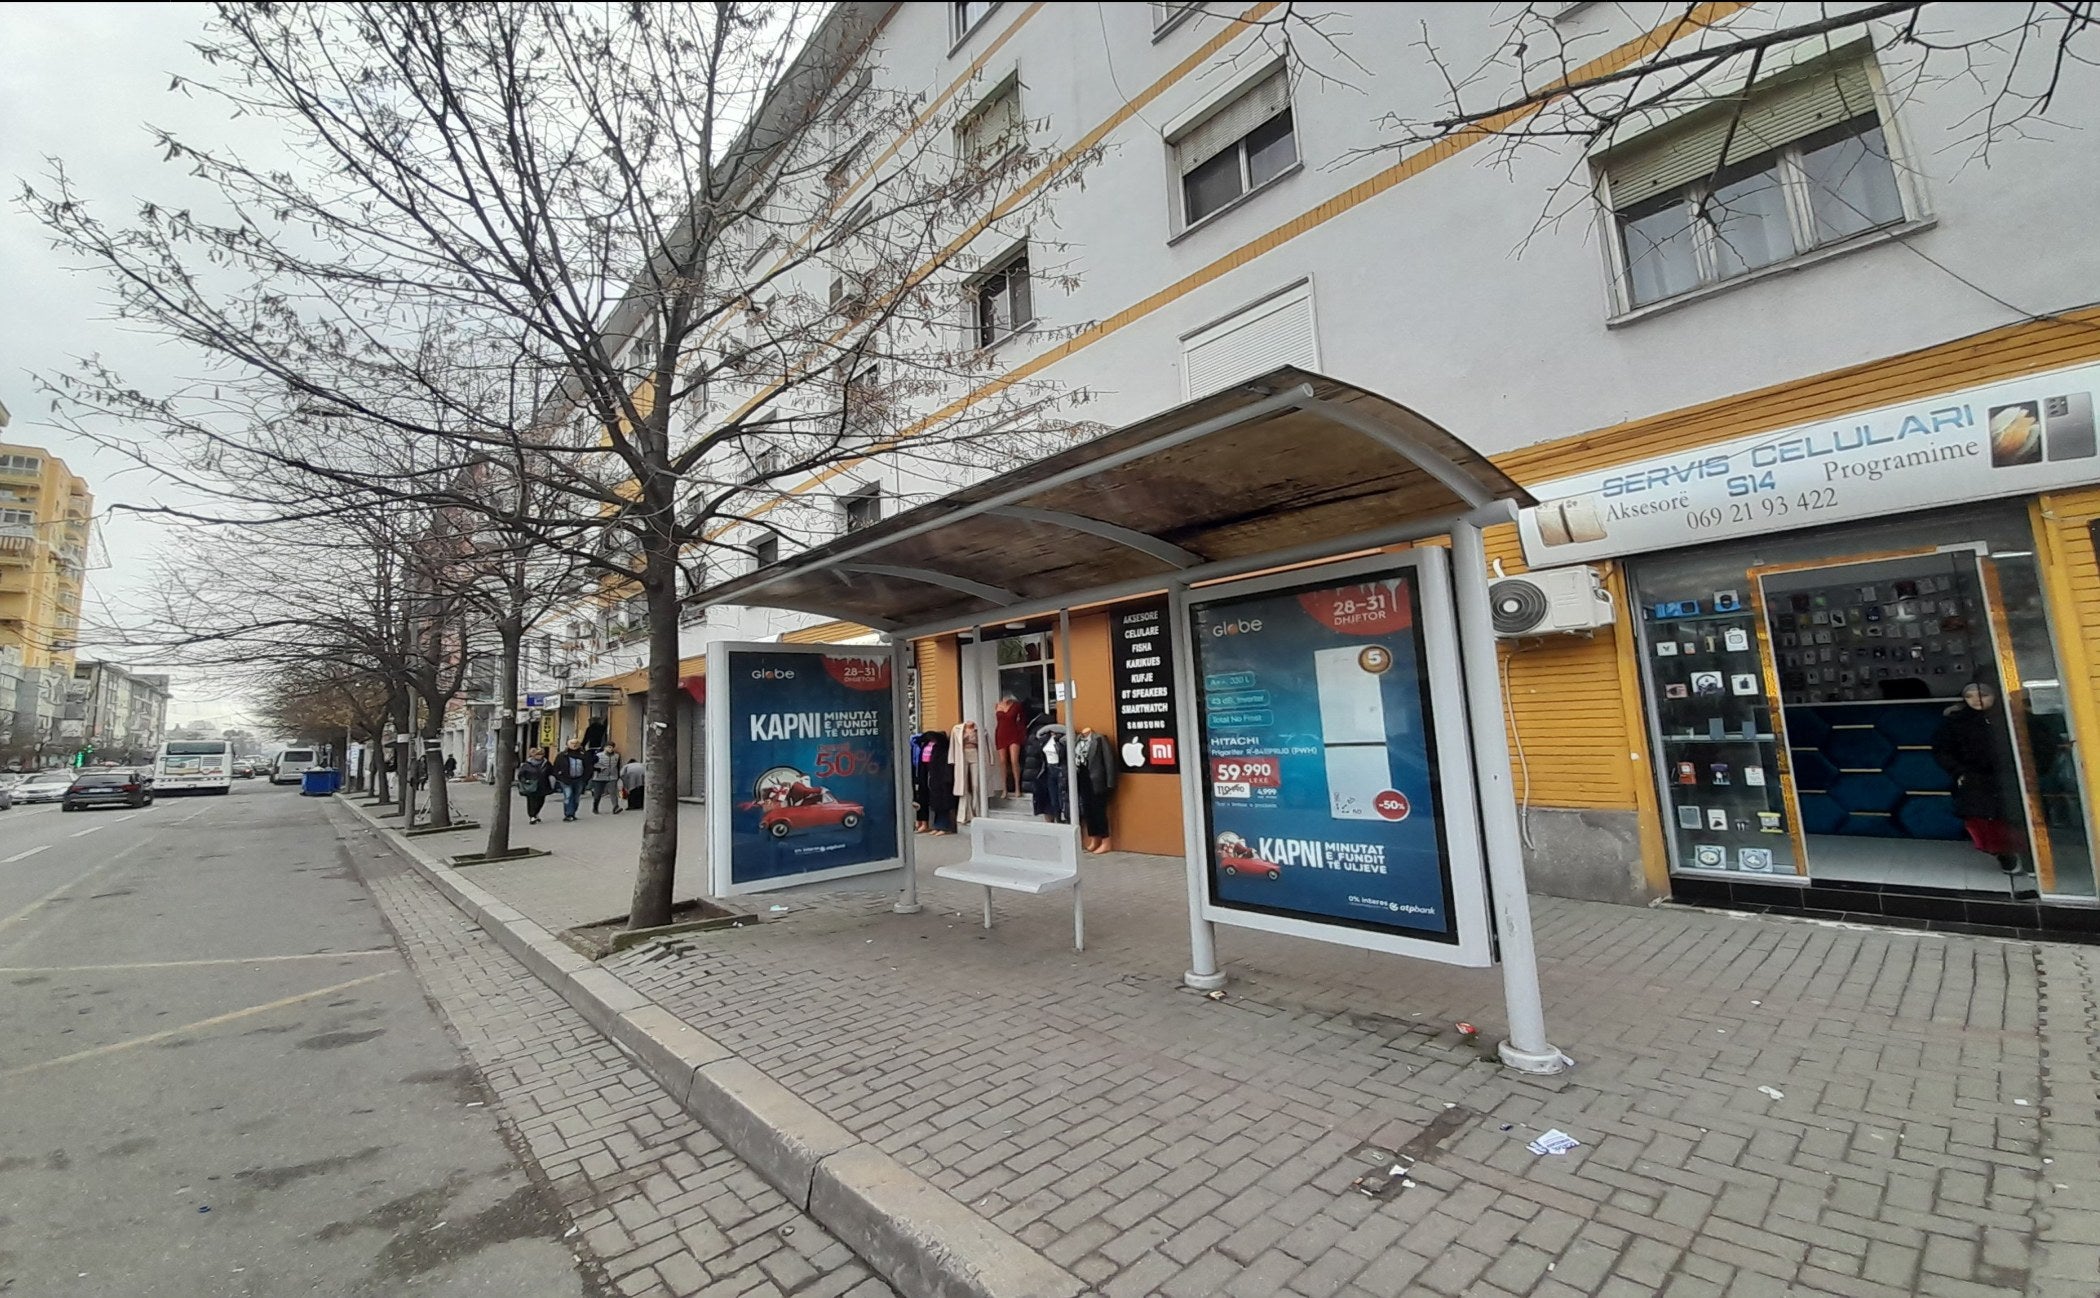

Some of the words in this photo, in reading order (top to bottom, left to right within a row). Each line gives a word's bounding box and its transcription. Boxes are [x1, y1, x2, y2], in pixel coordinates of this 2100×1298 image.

[1602, 455, 1730, 498] SERVIS
[1751, 404, 1974, 468] CELULARI
[1823, 437, 1980, 482] Programime
[1727, 470, 1776, 498] S14
[1687, 507, 1722, 531] 069
[1731, 502, 1753, 523] 21
[1762, 495, 1789, 518] 93
[1796, 487, 1838, 512] 422
[1123, 611, 1159, 624] AKSESORE
[1334, 610, 1386, 626] DHJETOR
[1124, 626, 1159, 639] CELULARE
[1132, 642, 1152, 653] FISHA
[1126, 656, 1161, 669] KARIKUES
[1367, 651, 1382, 665] 5
[751, 668, 795, 679] Globe
[1131, 673, 1153, 683] KUFJE
[1132, 687, 1168, 699] SPEAKERS
[1121, 703, 1168, 714] SMARTWATCH
[824, 711, 878, 720] MINUTAT
[1212, 715, 1229, 723] Total
[750, 712, 821, 741] KAPNI
[824, 721, 832, 729] E
[837, 720, 878, 728] FUNDIT
[1127, 720, 1165, 730] SAMSUNG
[841, 728, 879, 737] ULJEVE
[1210, 737, 1259, 746] HITACHI
[815, 751, 879, 778] 50%
[1218, 764, 1271, 781] 59.990
[1378, 800, 1405, 811] -50%
[1259, 837, 1323, 868] KAPNI
[1324, 842, 1384, 855] MINUTAT
[1326, 851, 1334, 860] E
[1338, 852, 1386, 865] FUNDIT
[1344, 862, 1388, 875] ULJEVE
